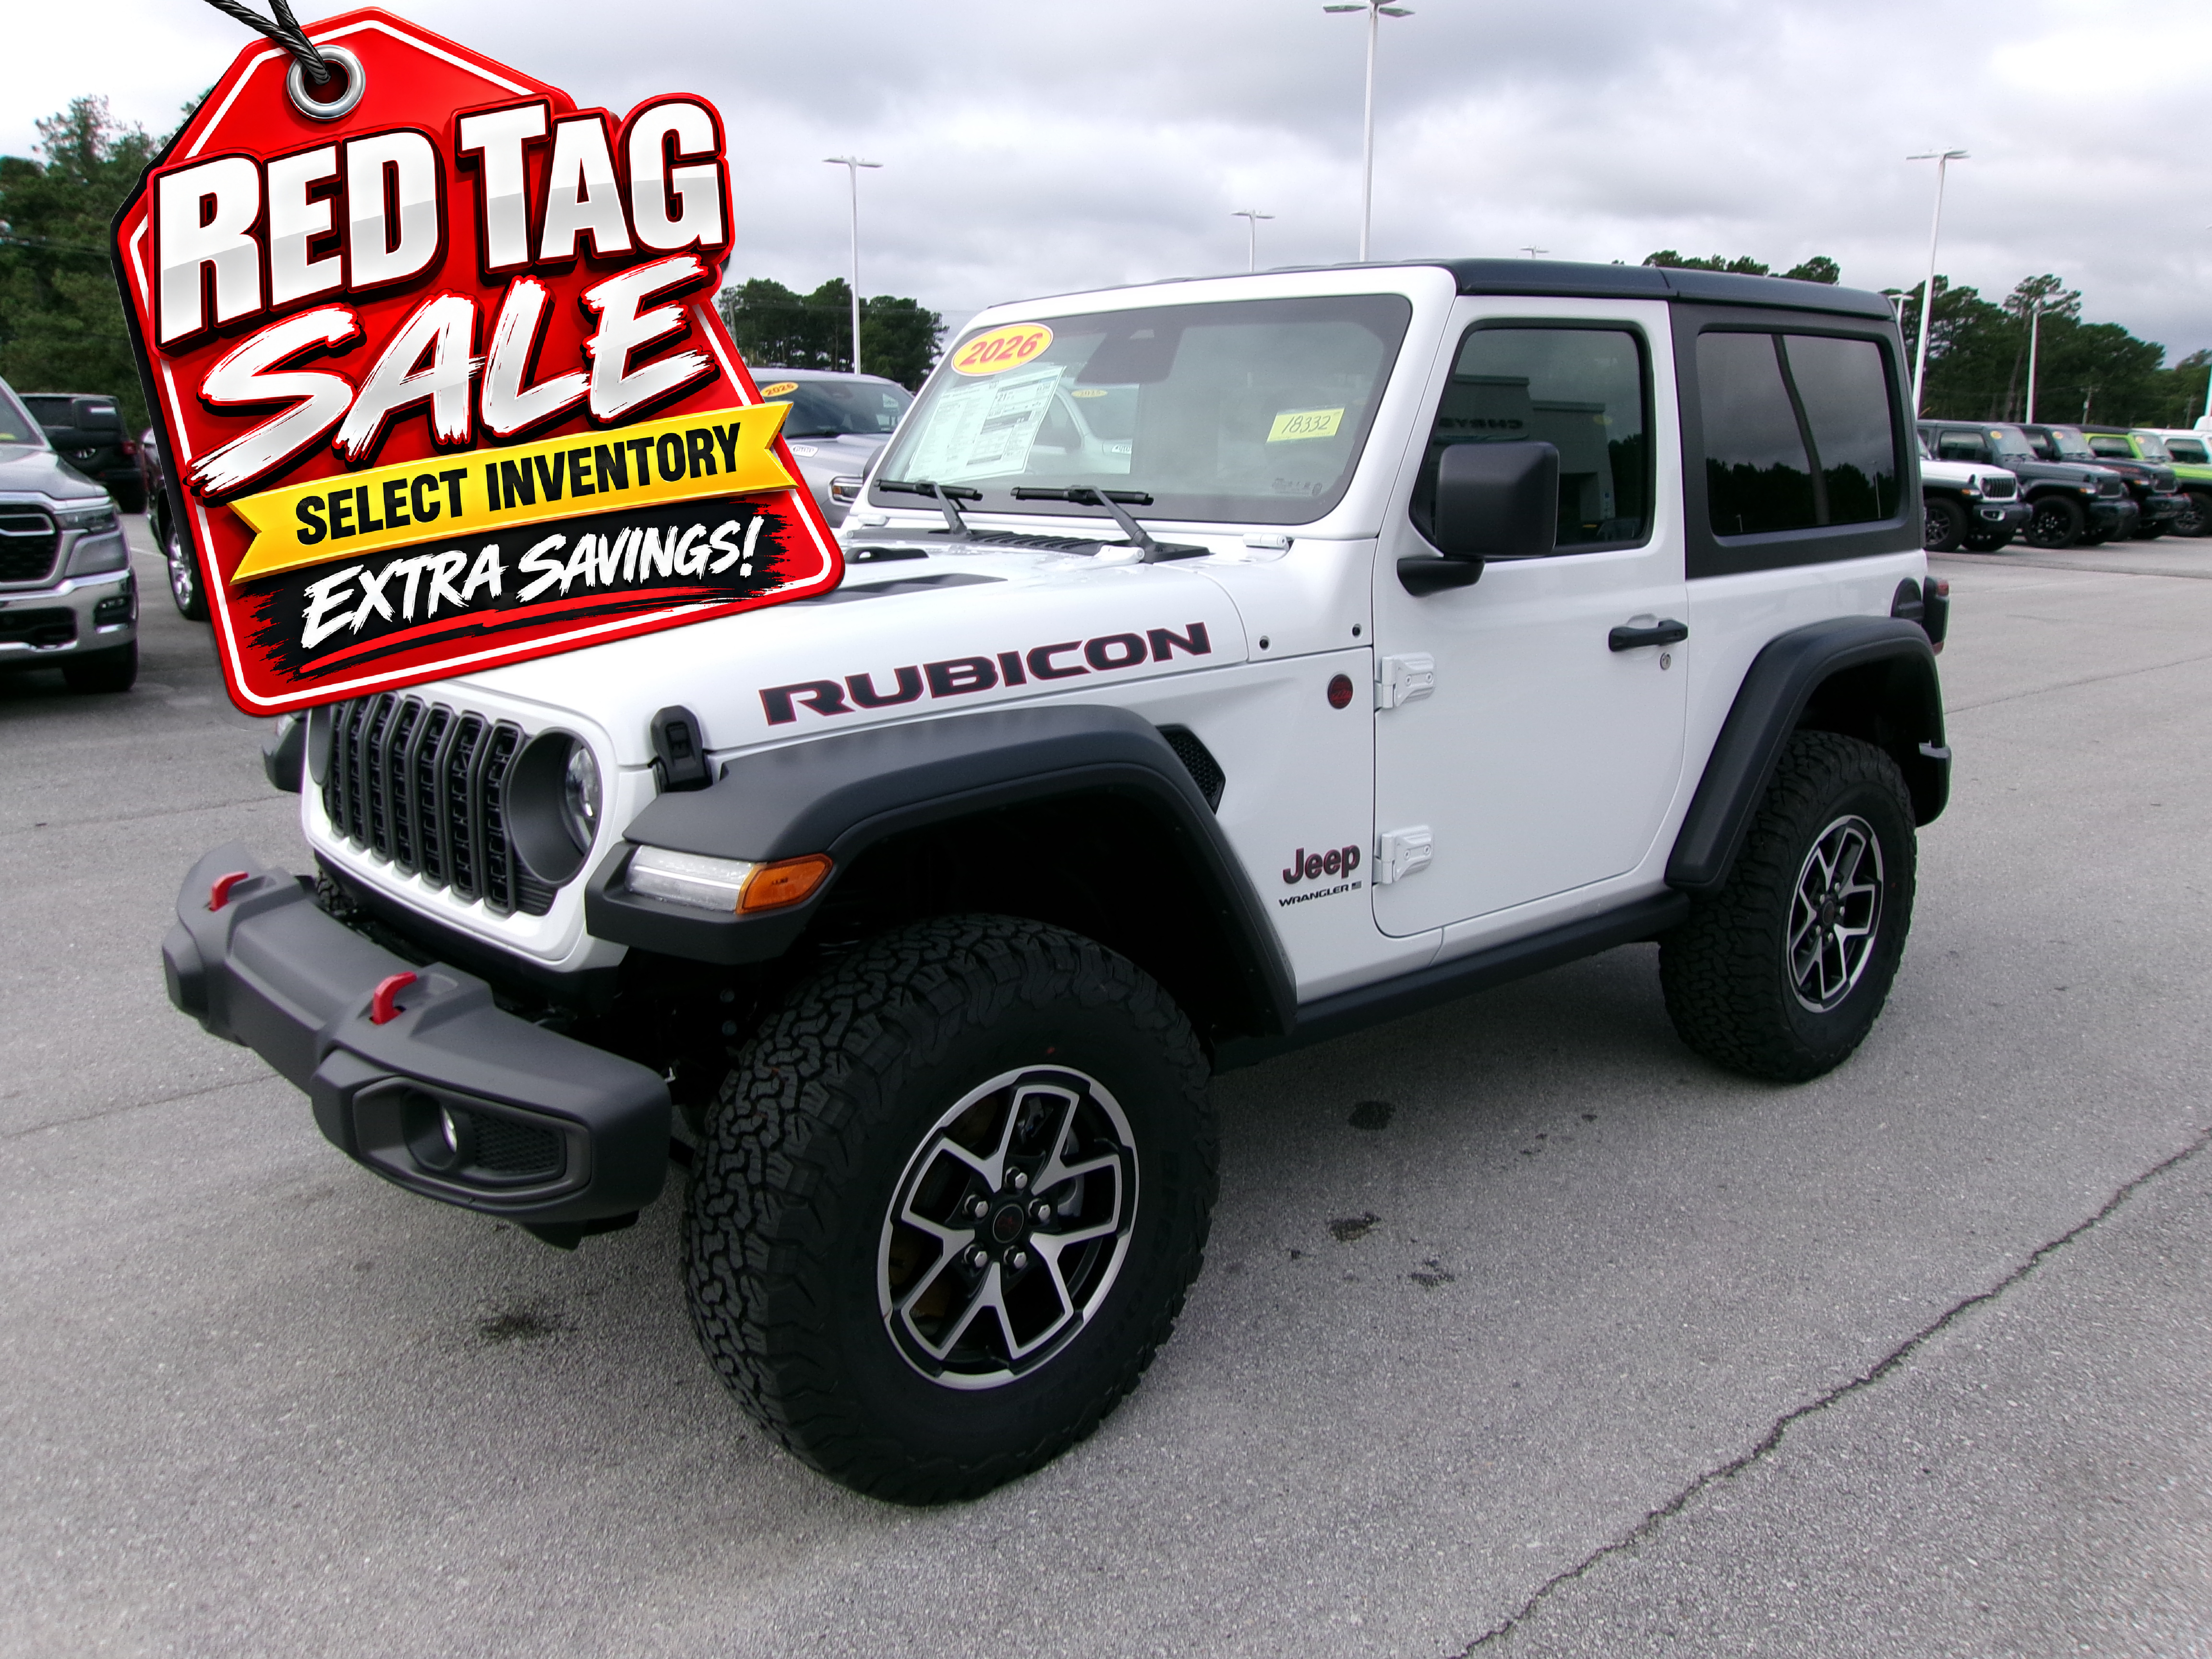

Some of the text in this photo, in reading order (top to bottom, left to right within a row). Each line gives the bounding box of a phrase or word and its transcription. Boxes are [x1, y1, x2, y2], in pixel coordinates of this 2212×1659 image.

[959, 333, 1042, 367] 2026
[1281, 415, 1331, 434] 18332
[758, 621, 1212, 726] RUBICON
[1283, 845, 1361, 884] Jeep
[1278, 884, 1349, 907] WRANGLER
